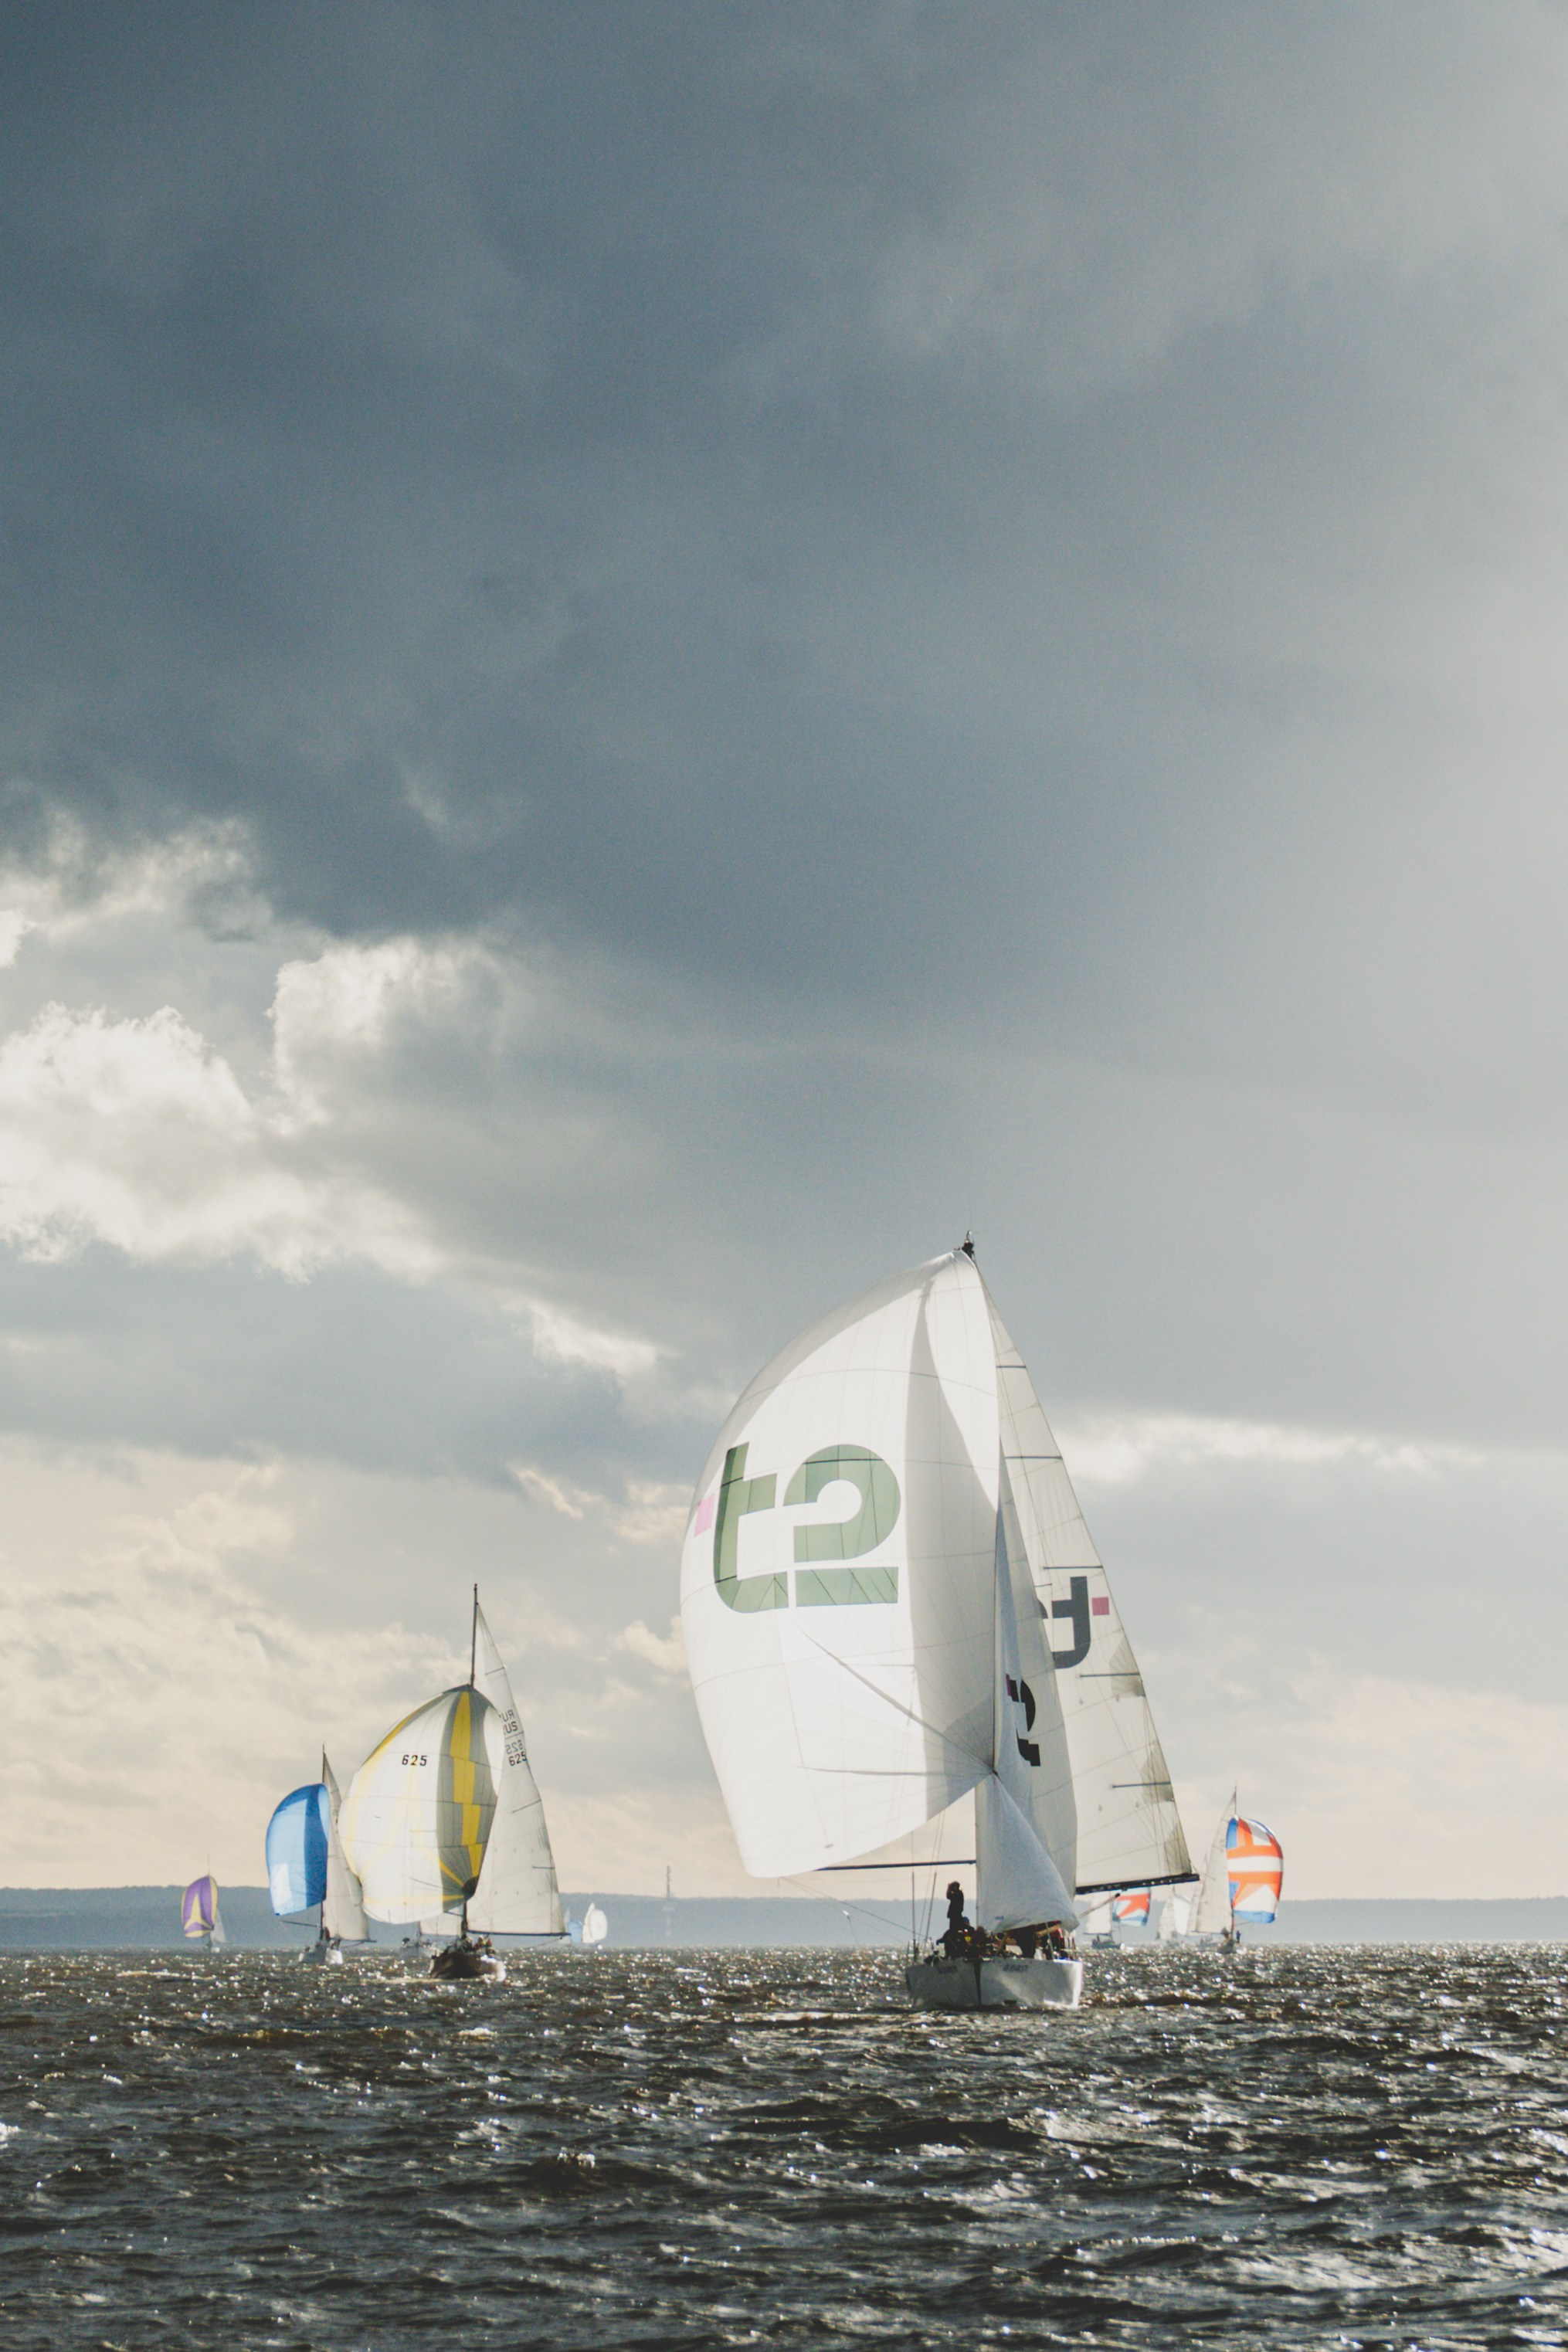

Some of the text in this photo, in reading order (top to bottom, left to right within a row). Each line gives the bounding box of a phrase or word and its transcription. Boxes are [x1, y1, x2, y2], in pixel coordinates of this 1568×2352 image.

[503, 1721, 518, 1734] US
[402, 1754, 428, 1767] 625
[509, 1751, 528, 1767] 625
